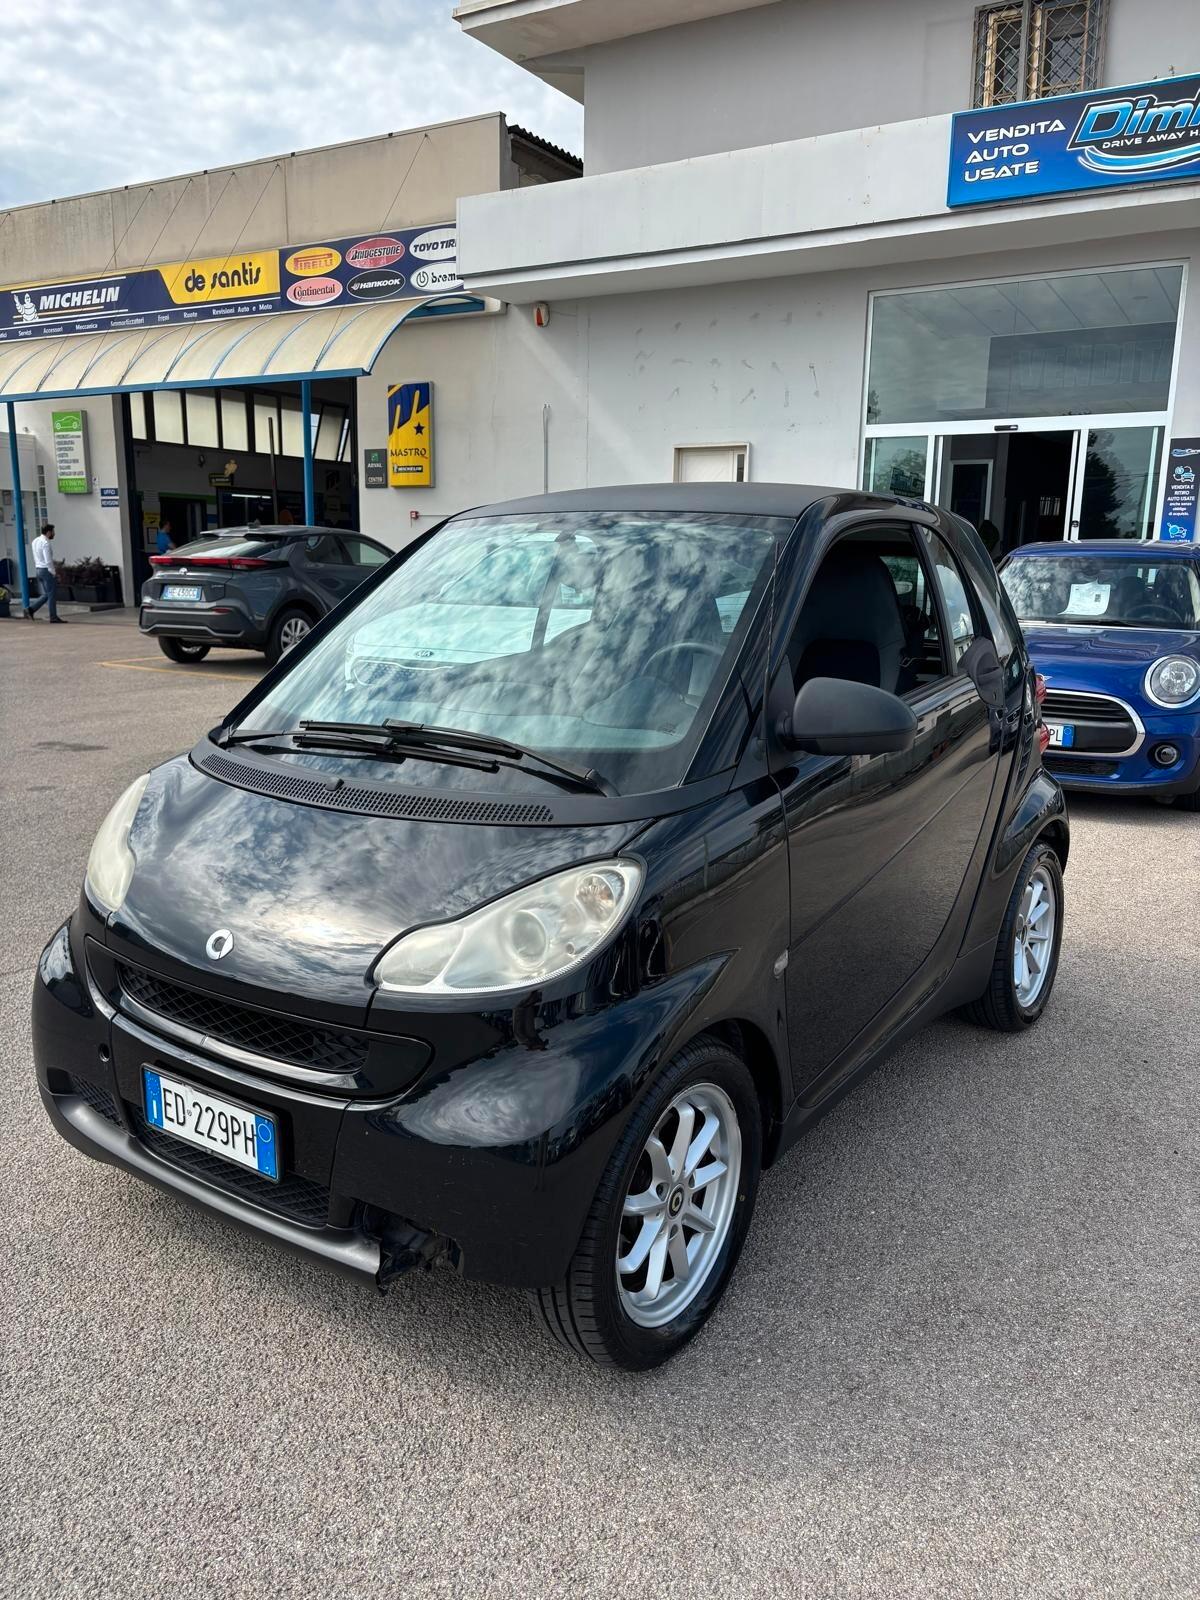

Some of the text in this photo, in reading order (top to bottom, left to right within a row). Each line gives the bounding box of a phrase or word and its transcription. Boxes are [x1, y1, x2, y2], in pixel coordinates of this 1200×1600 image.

[1075, 97, 1200, 144] Dim
[967, 119, 1066, 144] VENDITA
[1102, 128, 1200, 149] DRIVE AWAY H
[965, 143, 1030, 164] AUTO
[963, 161, 1039, 182] USATE
[351, 246, 401, 261] BRIDGESTONE
[413, 238, 456, 253] TOYO TIR
[293, 253, 334, 271] PIRELLI
[184, 262, 261, 293] de santis
[39, 286, 121, 311] MICHELIN
[293, 284, 336, 300] Continental
[43, 326, 64, 334] Accessori
[75, 323, 98, 331] Meccanica
[183, 311, 198, 319] Ruote
[212, 306, 235, 316] Revisioni
[237, 304, 250, 313] Auto
[258, 303, 273, 311] Moto
